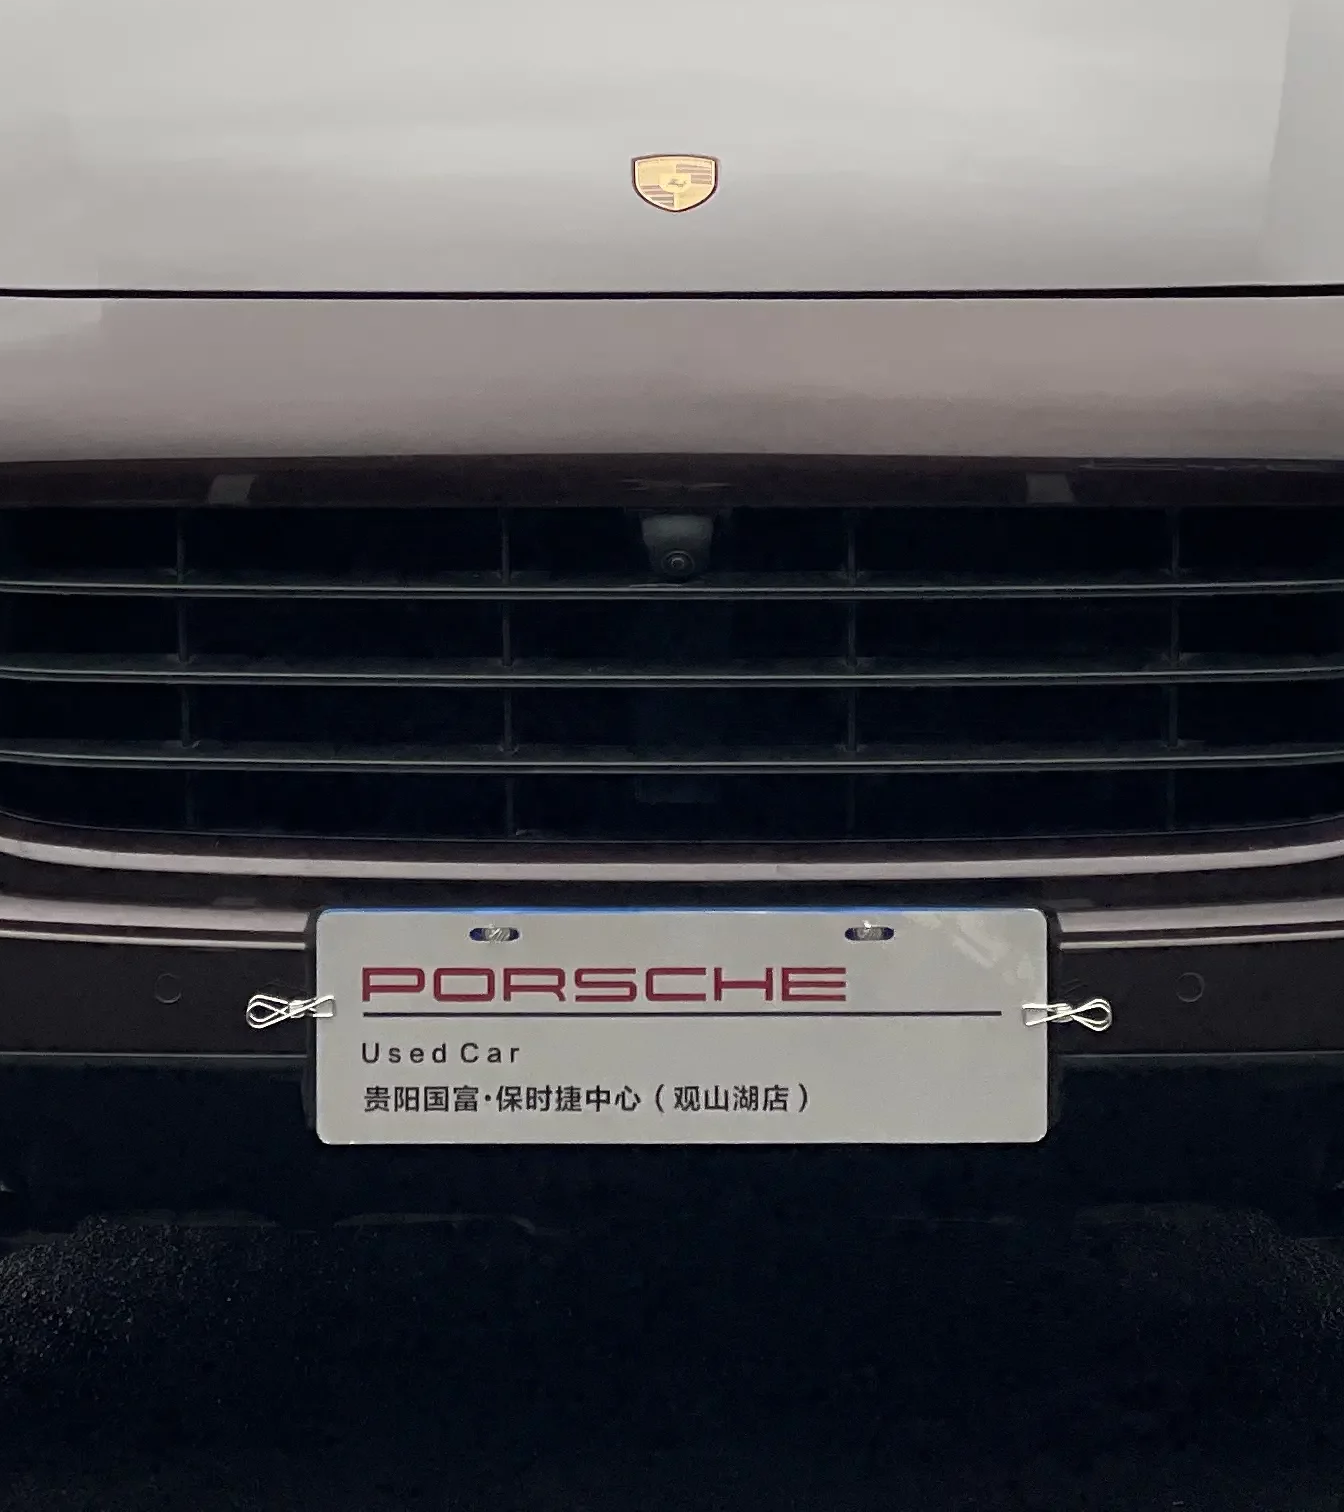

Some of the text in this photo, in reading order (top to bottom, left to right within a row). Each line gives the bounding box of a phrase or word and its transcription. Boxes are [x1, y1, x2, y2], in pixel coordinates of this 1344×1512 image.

[361, 966, 847, 1003] PORSCHE
[361, 1041, 520, 1065] Used Car
